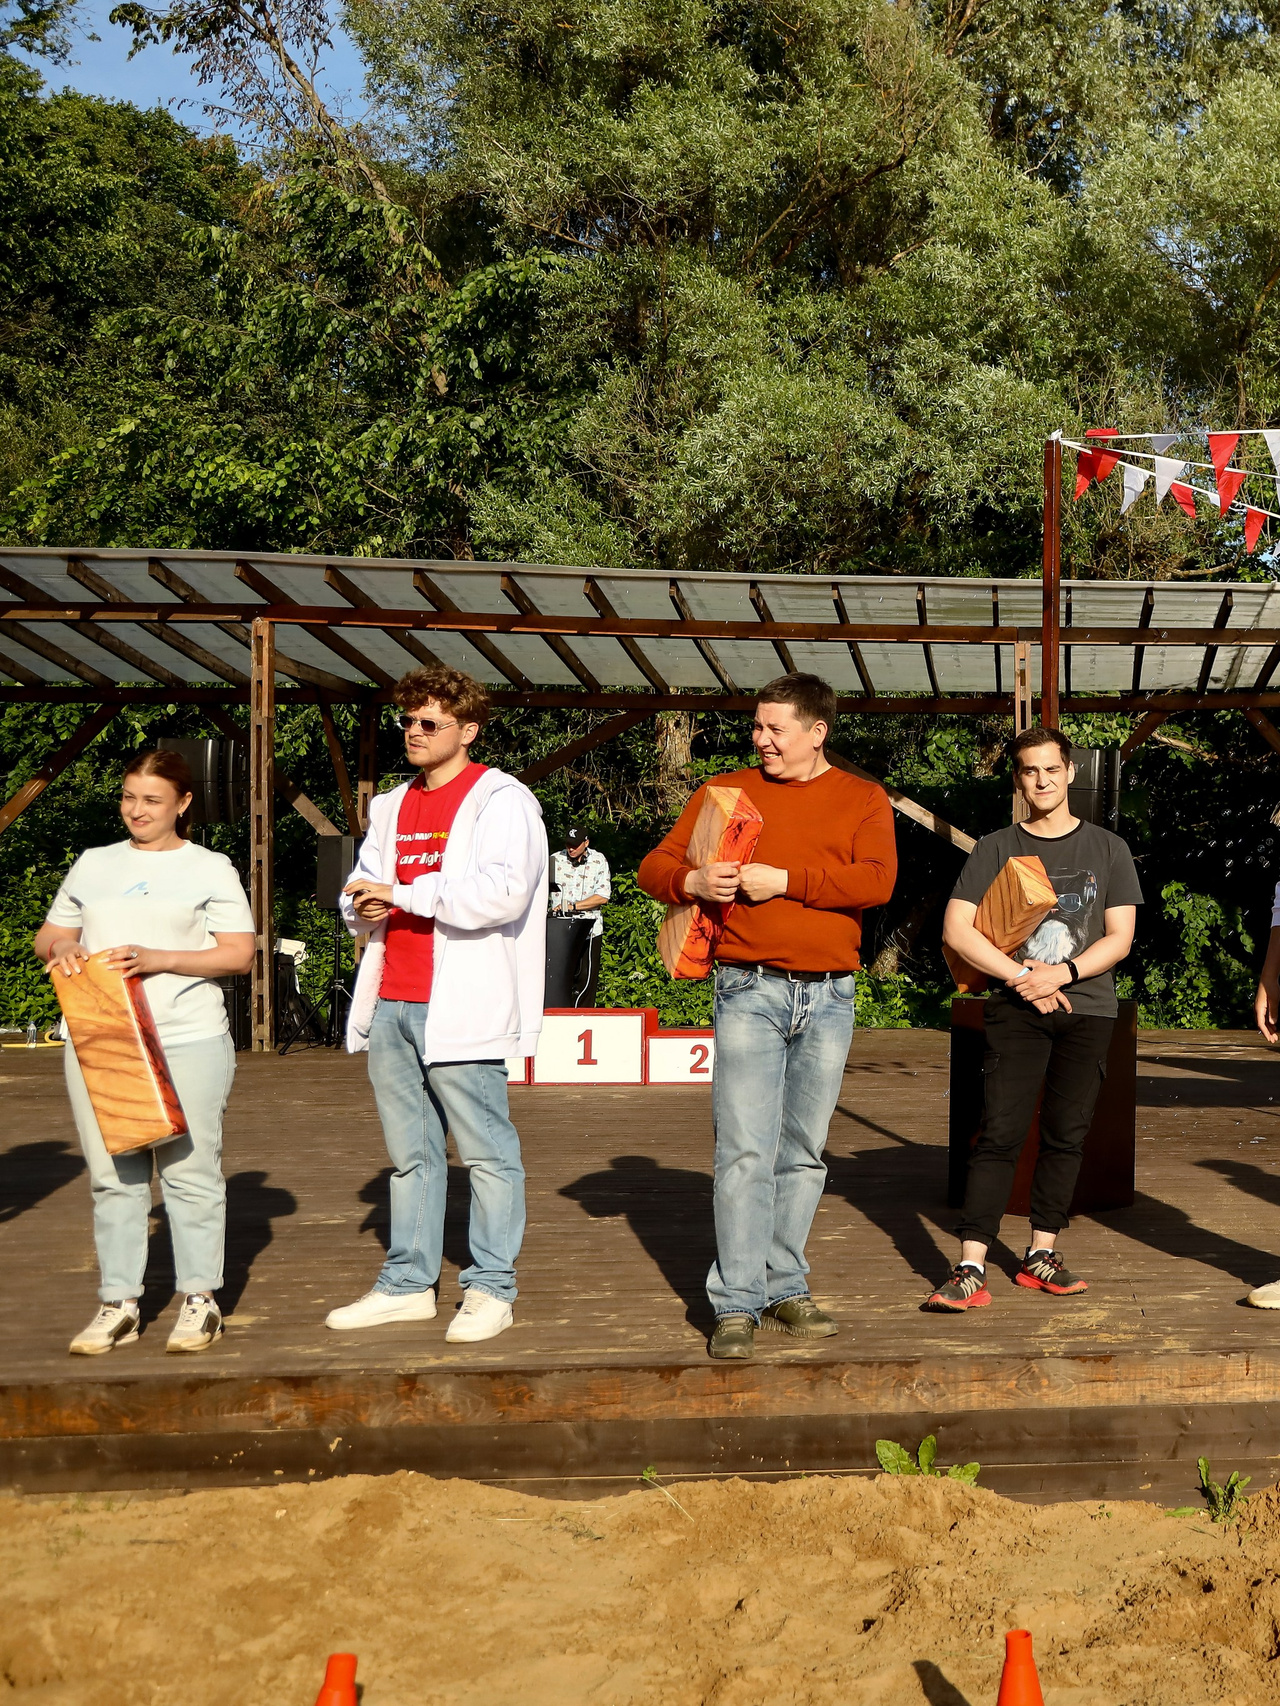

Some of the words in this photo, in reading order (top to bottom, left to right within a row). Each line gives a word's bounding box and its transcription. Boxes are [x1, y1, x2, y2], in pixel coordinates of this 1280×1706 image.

[400, 850, 445, 866] arligh
[577, 1029, 598, 1065] 1
[689, 1044, 710, 1074] 2
